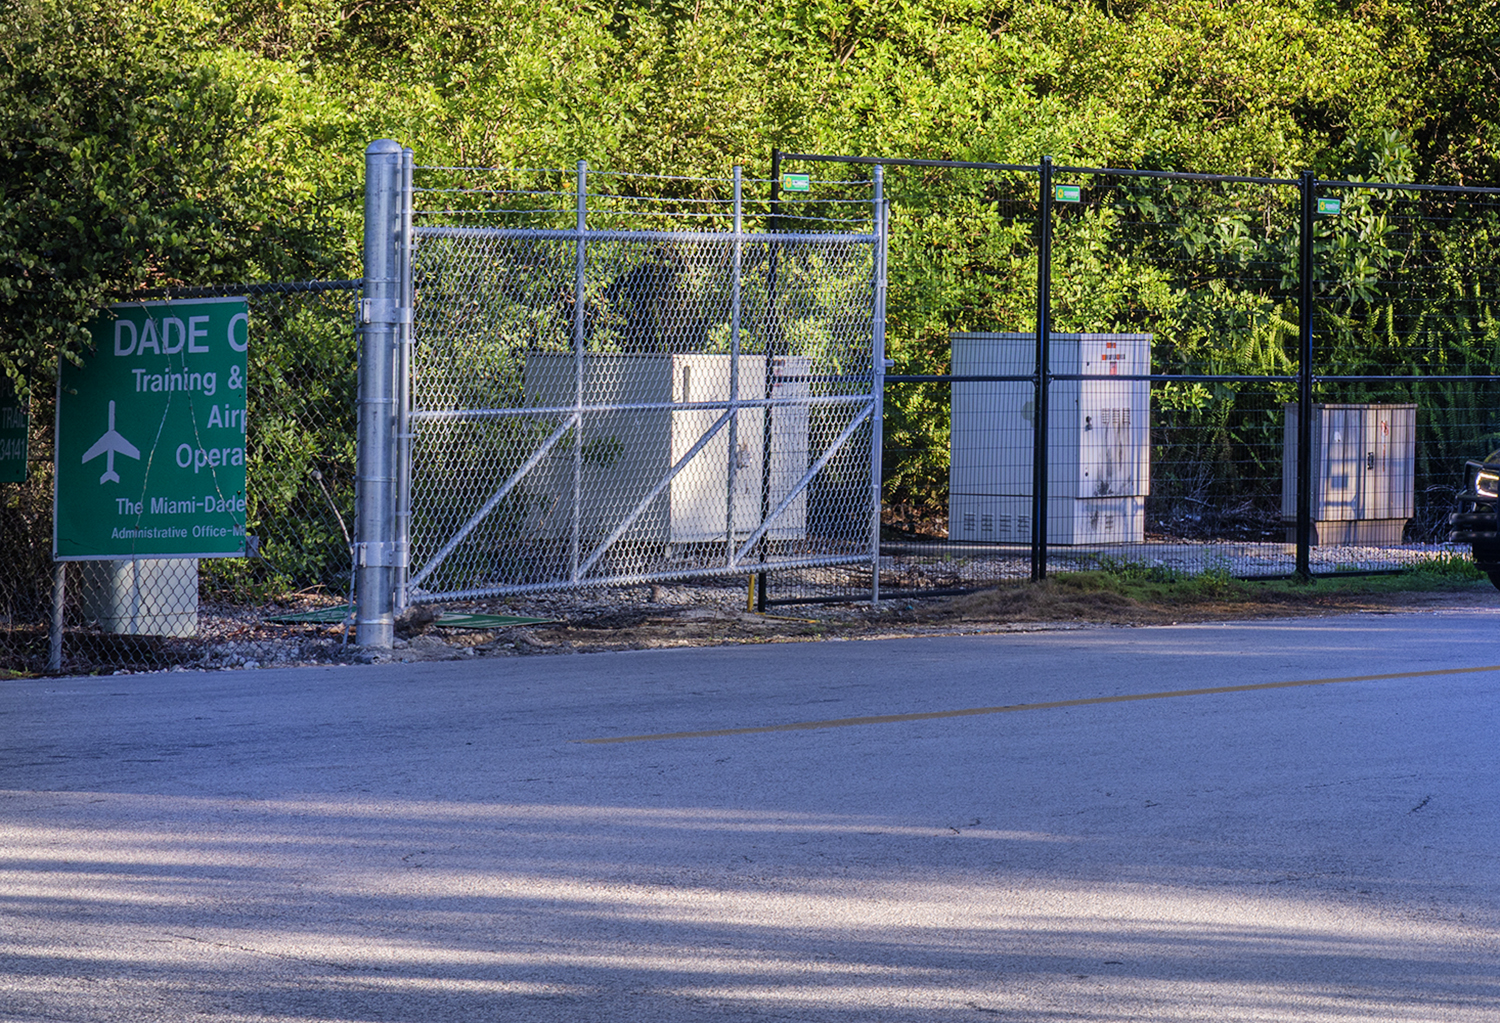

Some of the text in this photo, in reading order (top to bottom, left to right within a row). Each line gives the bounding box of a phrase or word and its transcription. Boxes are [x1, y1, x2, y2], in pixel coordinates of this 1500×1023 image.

[114, 315, 210, 356] DADE
[131, 365, 243, 396] Training &
[176, 443, 247, 474] Opera
[115, 497, 143, 515] The
[111, 525, 187, 539] Administrative
